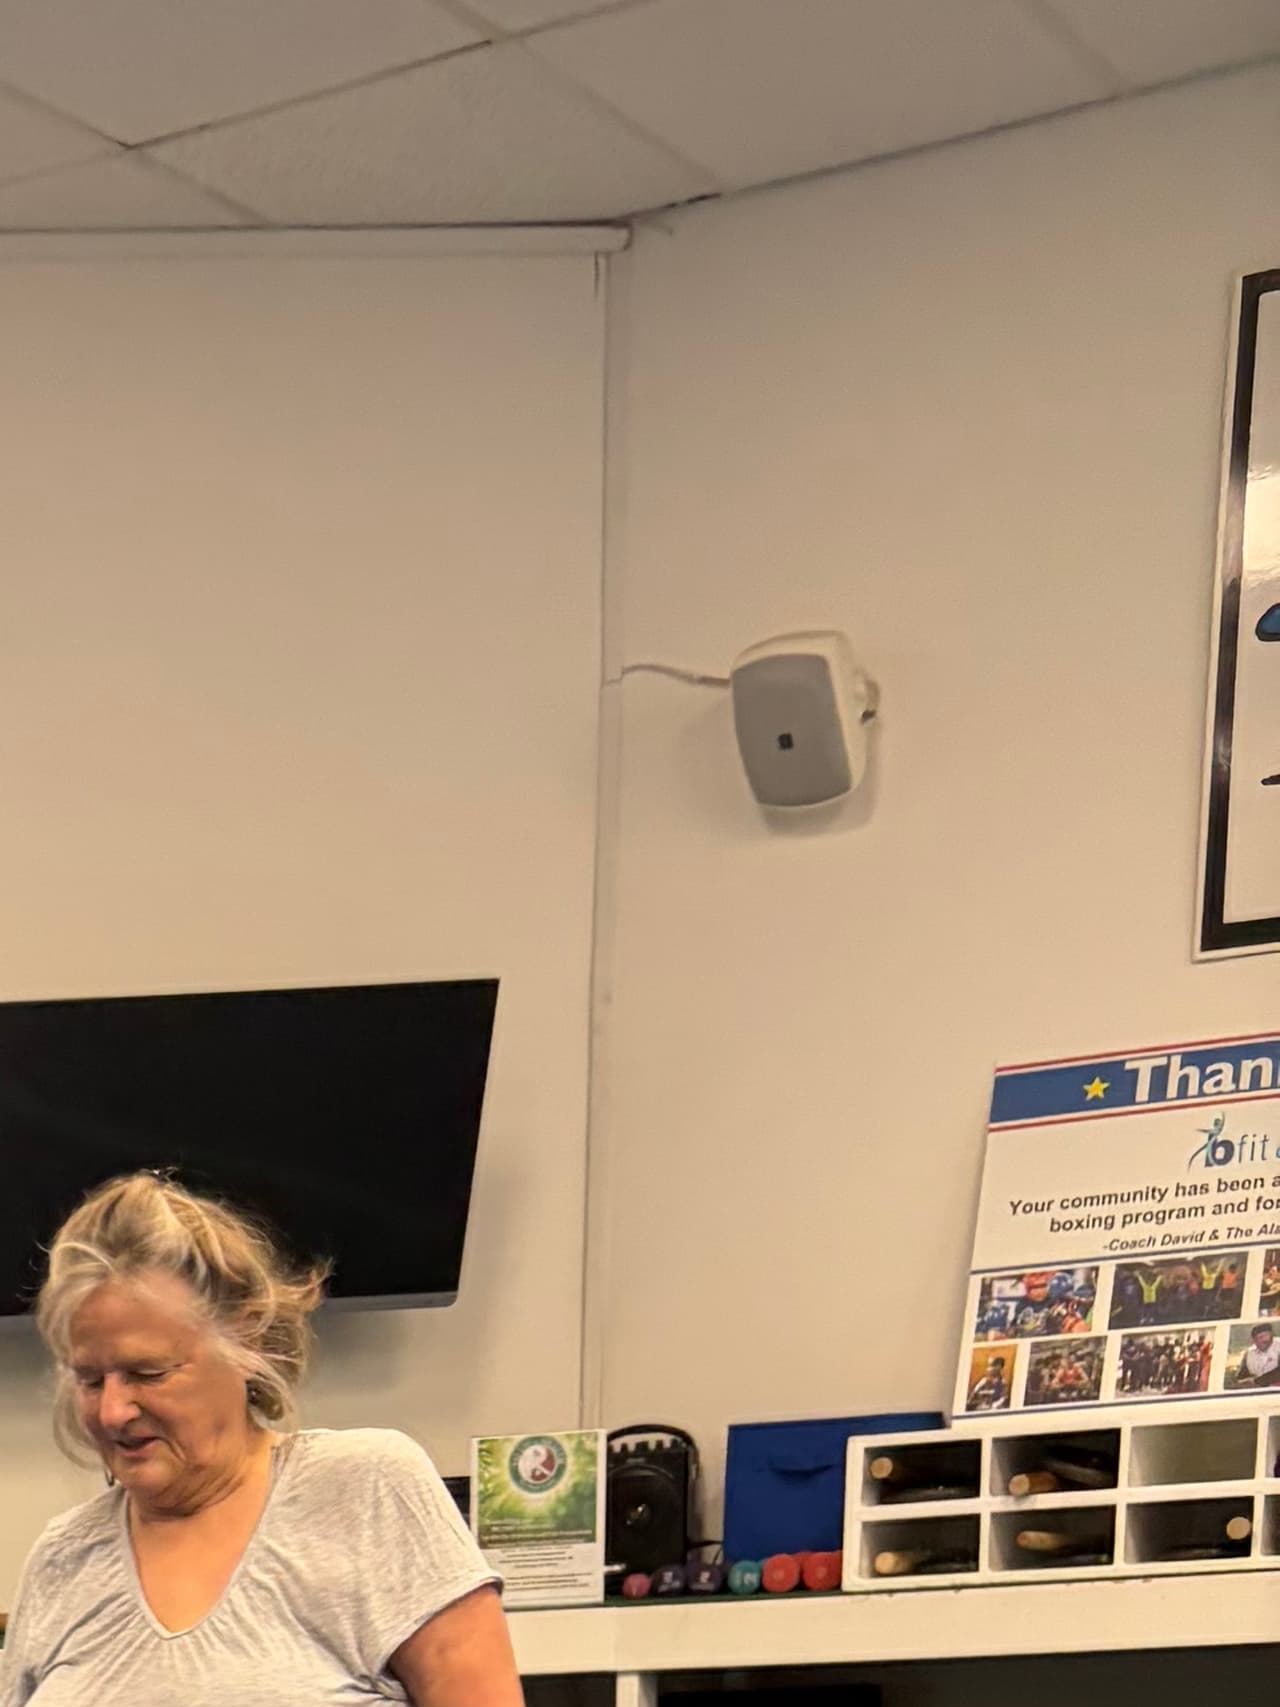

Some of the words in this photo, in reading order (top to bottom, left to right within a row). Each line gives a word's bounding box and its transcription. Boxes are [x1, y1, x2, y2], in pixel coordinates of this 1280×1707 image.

[1124, 1054, 1280, 1104] Than
[1009, 1199, 1055, 1217] Your
[1059, 1186, 1169, 1208] community
[1174, 1182, 1210, 1198] has
[1216, 1177, 1265, 1194] been
[1049, 1215, 1116, 1233] boxing
[1121, 1205, 1206, 1229] program
[1211, 1198, 1249, 1216] and
[1160, 1231, 1206, 1247] David
[1209, 1229, 1220, 1241] &
[1226, 1227, 1253, 1239] The
